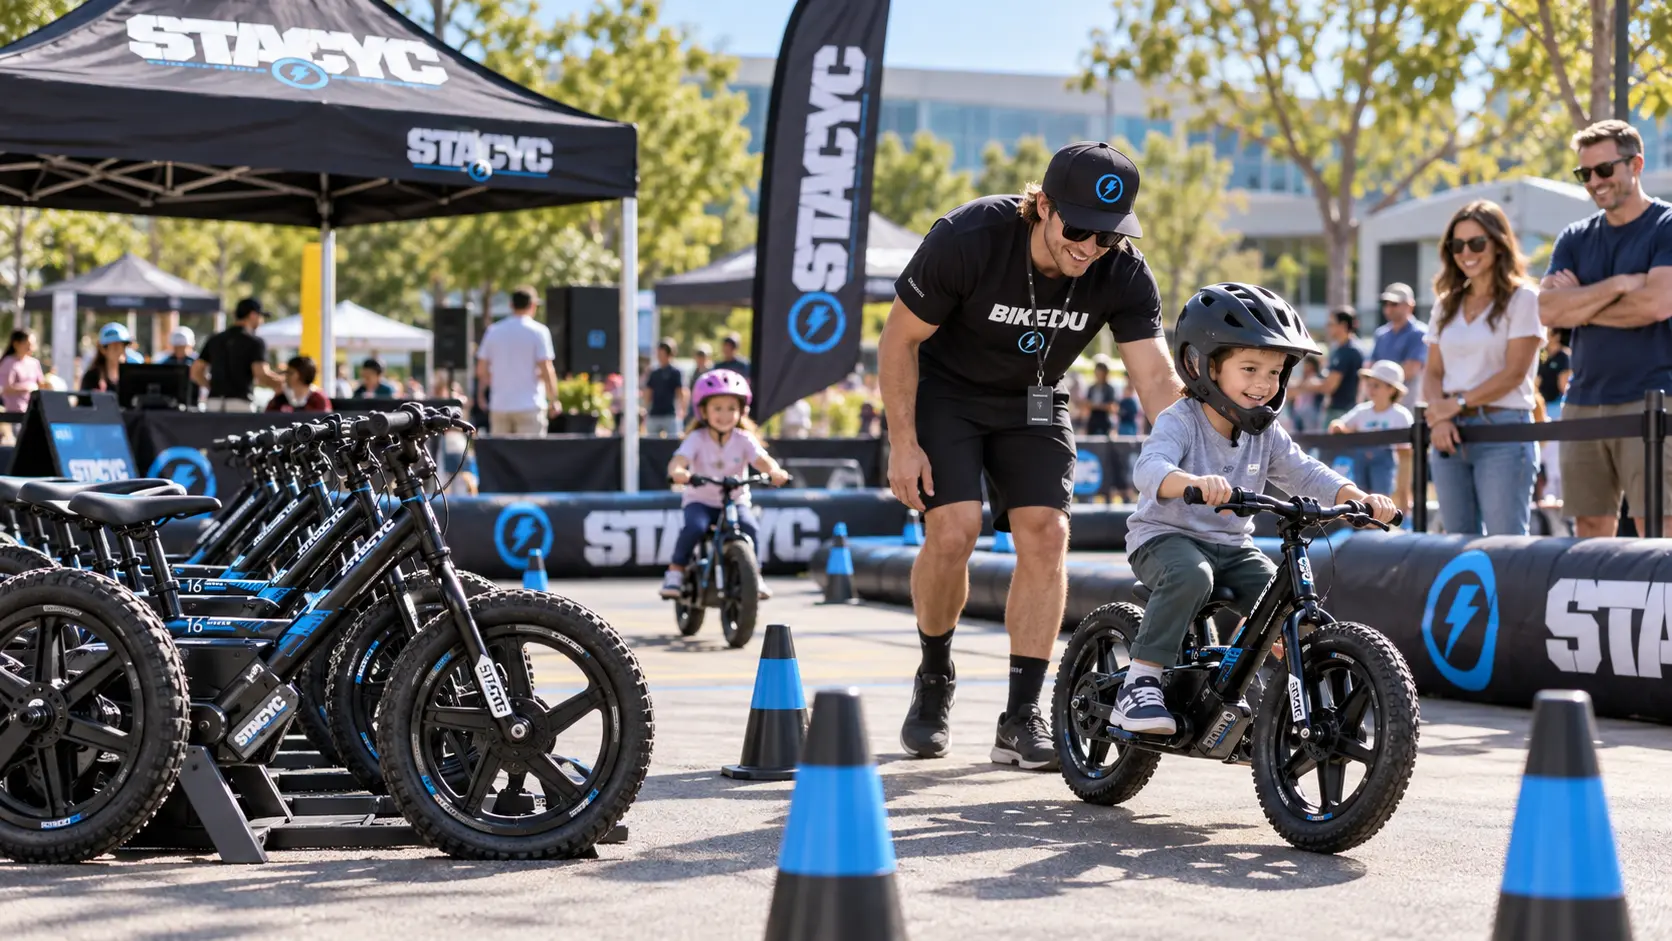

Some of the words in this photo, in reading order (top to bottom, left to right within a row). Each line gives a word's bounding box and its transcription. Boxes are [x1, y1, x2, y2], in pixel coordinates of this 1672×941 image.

[126, 14, 448, 85] STACYC
[407, 127, 553, 173] STACYC
[792, 45, 867, 293] STACYC
[988, 303, 1089, 331] BIKEDU
[187, 579, 202, 593] 16
[186, 617, 203, 633] 16
